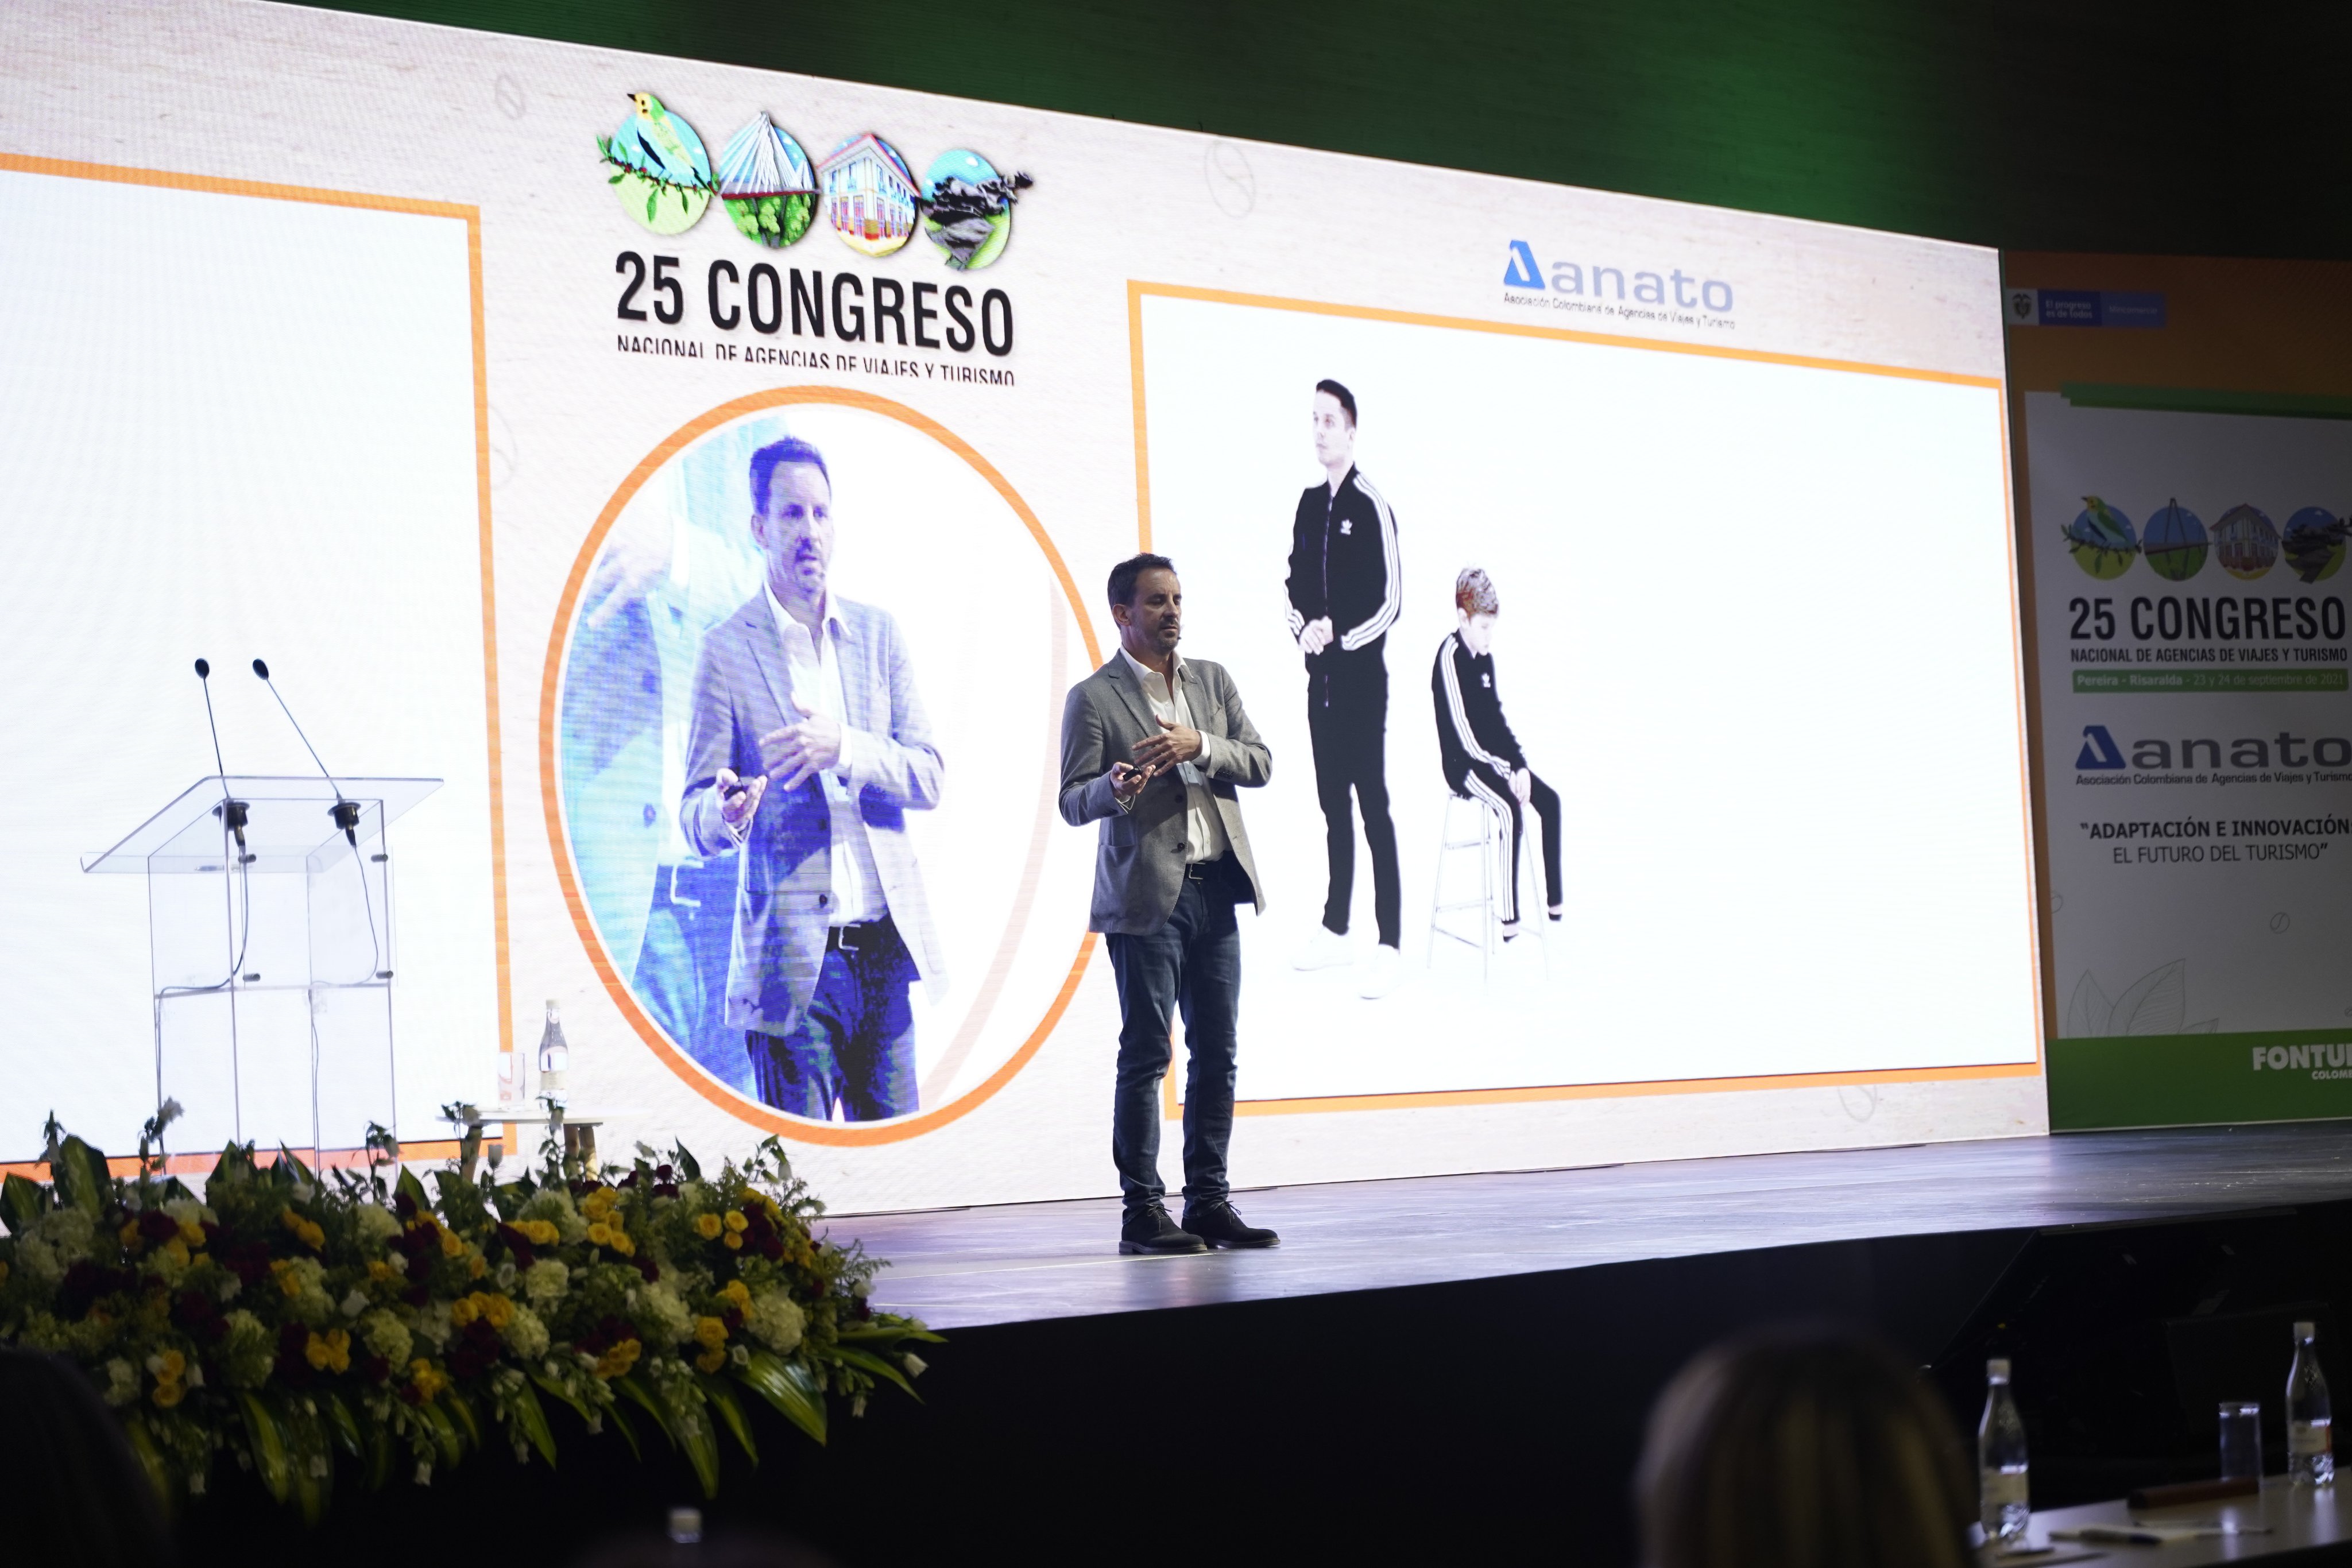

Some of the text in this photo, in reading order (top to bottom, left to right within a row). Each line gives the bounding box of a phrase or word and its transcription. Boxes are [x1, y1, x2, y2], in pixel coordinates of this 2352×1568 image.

[1552, 261, 1733, 312] anato
[615, 251, 1015, 357] 25 CONGRESO
[1504, 292, 1735, 330] Asociación Colombiana de Agencias de Viajes y Turismo
[924, 363, 934, 379] Y
[2069, 595, 2346, 641] 25 CONGRESO
[2071, 647, 2348, 663] NACIONAL DE AGENCIAS DE VIAJES Y TURISMO
[2077, 674, 2118, 686] Pereira
[2129, 674, 2183, 686] Risaralda
[2194, 674, 2206, 686] 23
[2209, 676, 2215, 686] y
[2218, 673, 2231, 686] 24
[2234, 674, 2246, 686] de
[2249, 673, 2303, 687] septiembre
[2305, 674, 2318, 685] de
[2320, 673, 2343, 685] 2021
[2132, 732, 2352, 769] anato
[2076, 773, 2131, 785] Asociación
[2134, 773, 2192, 785] Colombiana
[2195, 773, 2208, 784] de
[2212, 773, 2257, 786] Agencias
[2260, 772, 2272, 783] de
[2274, 772, 2303, 784] Viajes
[2306, 773, 2312, 785] y
[2217, 821, 2226, 837] E
[2231, 813, 2352, 837] INNOVACIÓN
[2113, 847, 2133, 864] EL
[2138, 845, 2204, 862] FUTURO
[2211, 845, 2241, 861] DEL
